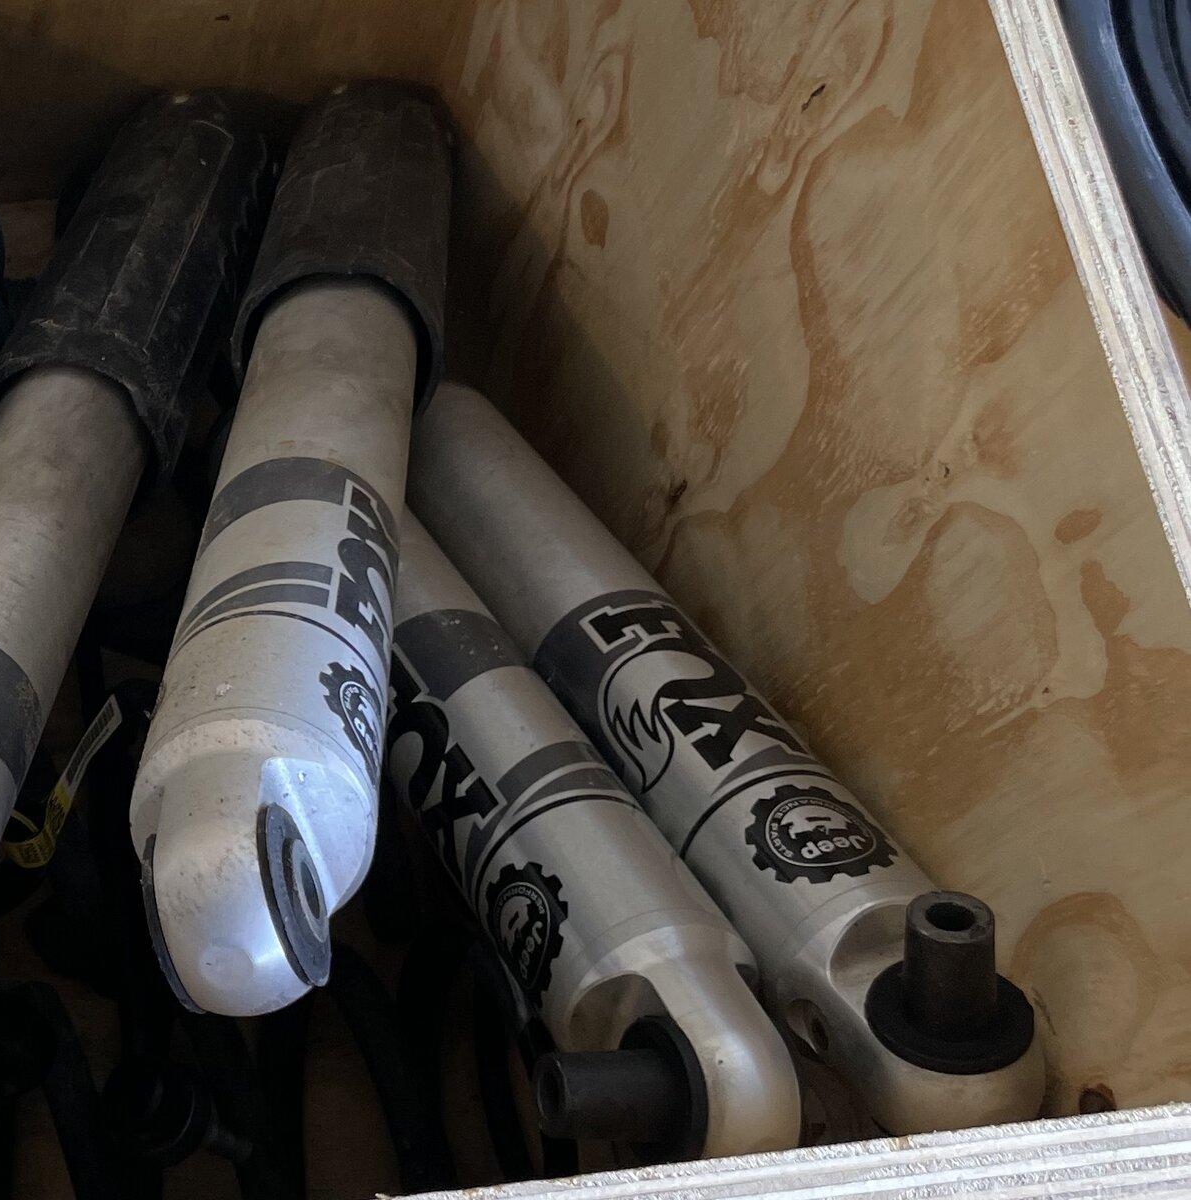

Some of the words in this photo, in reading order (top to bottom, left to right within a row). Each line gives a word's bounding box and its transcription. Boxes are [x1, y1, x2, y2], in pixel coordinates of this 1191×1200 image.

[581, 602, 809, 793] FOX
[800, 834, 866, 859] Jeep
[519, 921, 543, 980] Jeep
